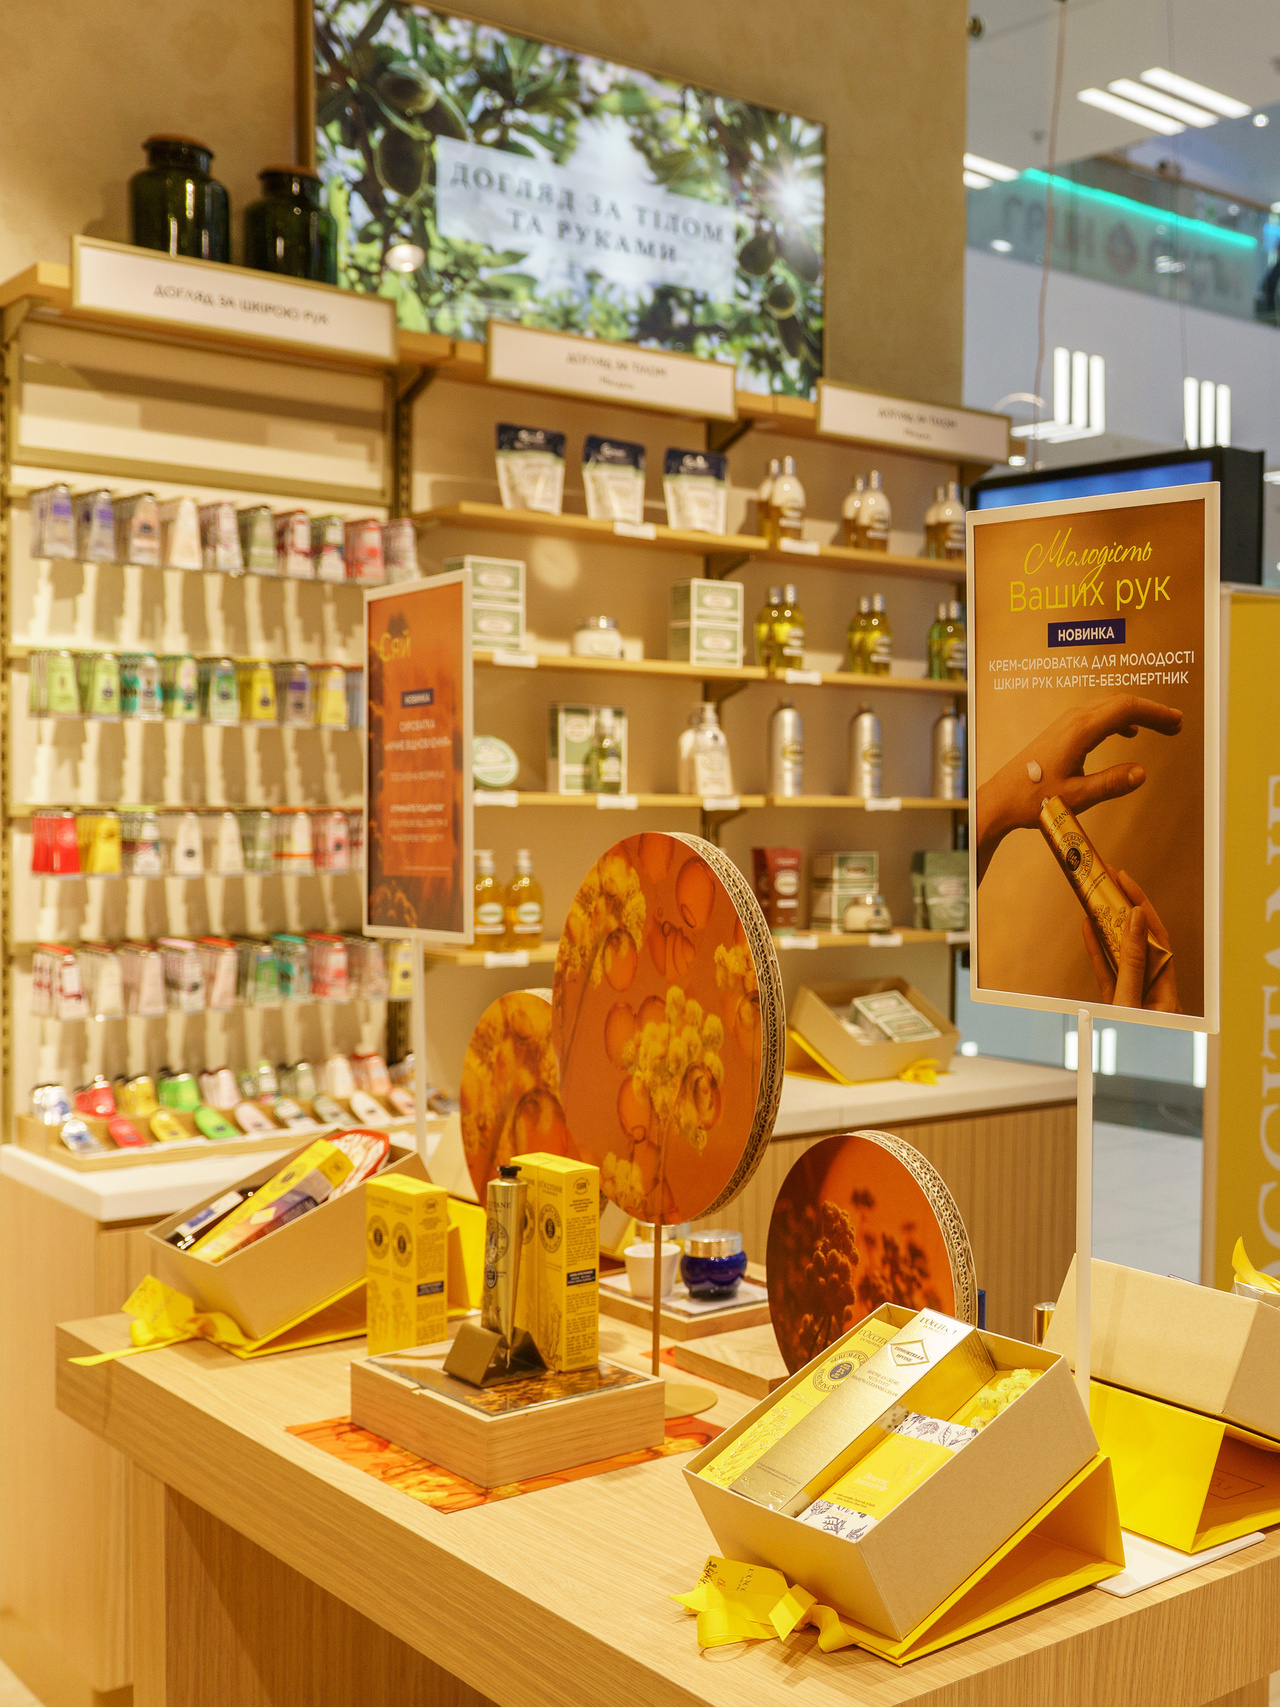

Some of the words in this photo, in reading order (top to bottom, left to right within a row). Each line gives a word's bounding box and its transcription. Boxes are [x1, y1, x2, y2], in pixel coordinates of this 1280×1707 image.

[450, 161, 576, 213] ДОГЛЯД
[585, 193, 622, 221] ЗА
[634, 204, 724, 243] ТІЛОМ
[507, 208, 543, 235] ТА
[557, 219, 678, 262] РУКАМИ
[1024, 527, 1153, 593] Молодість
[1010, 580, 1105, 612] Ваших
[1116, 575, 1171, 611] рук
[1057, 626, 1115, 642] НОВИНКА
[989, 656, 1088, 672] КРЕМ-СИРОВАТКА
[1091, 654, 1117, 670] ДЛЯ
[1119, 650, 1195, 667] МОЛОДОСТІ
[993, 677, 1029, 691] ШКІРИ
[1032, 676, 1053, 689] РУК
[1056, 671, 1189, 688] КАРІТЕ-БЕЗСМЕРТНИК
